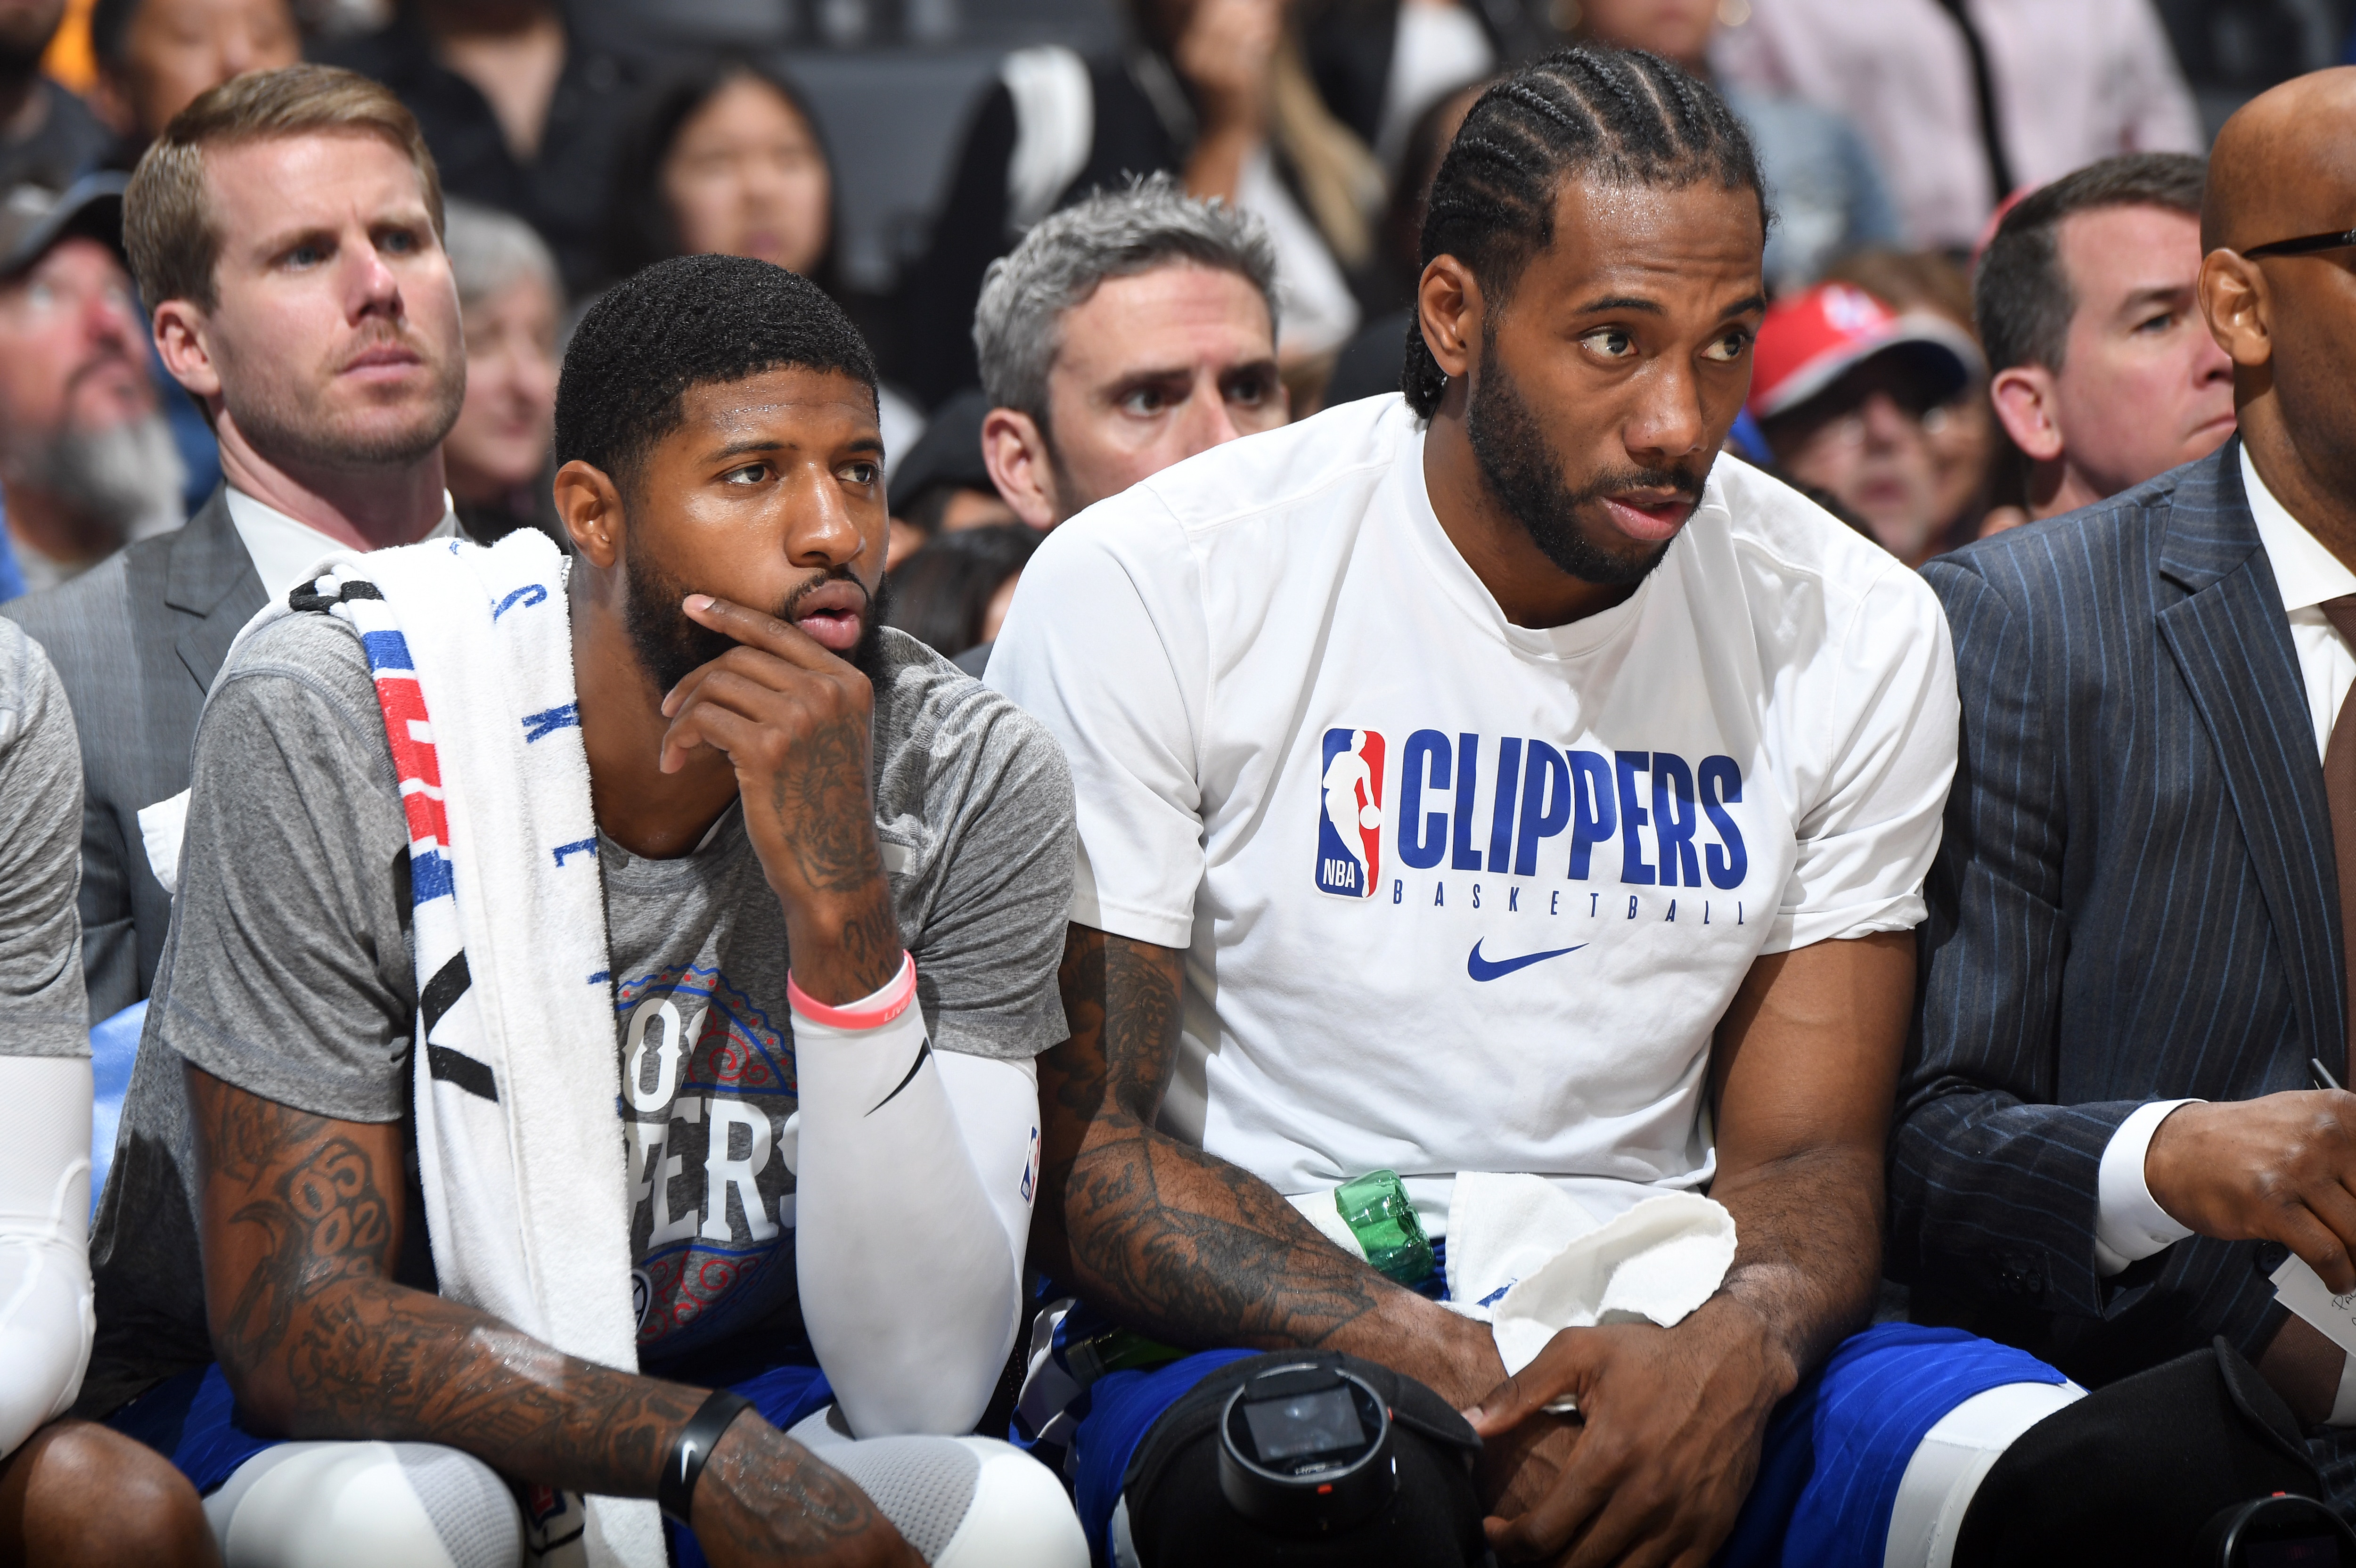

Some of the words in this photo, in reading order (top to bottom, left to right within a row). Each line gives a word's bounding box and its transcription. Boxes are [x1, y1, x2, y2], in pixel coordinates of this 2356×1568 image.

[1398, 728, 1749, 890] CLIPPERS
[1323, 858, 1355, 889] NBA
[1393, 879, 1744, 925] BASKETBALL
